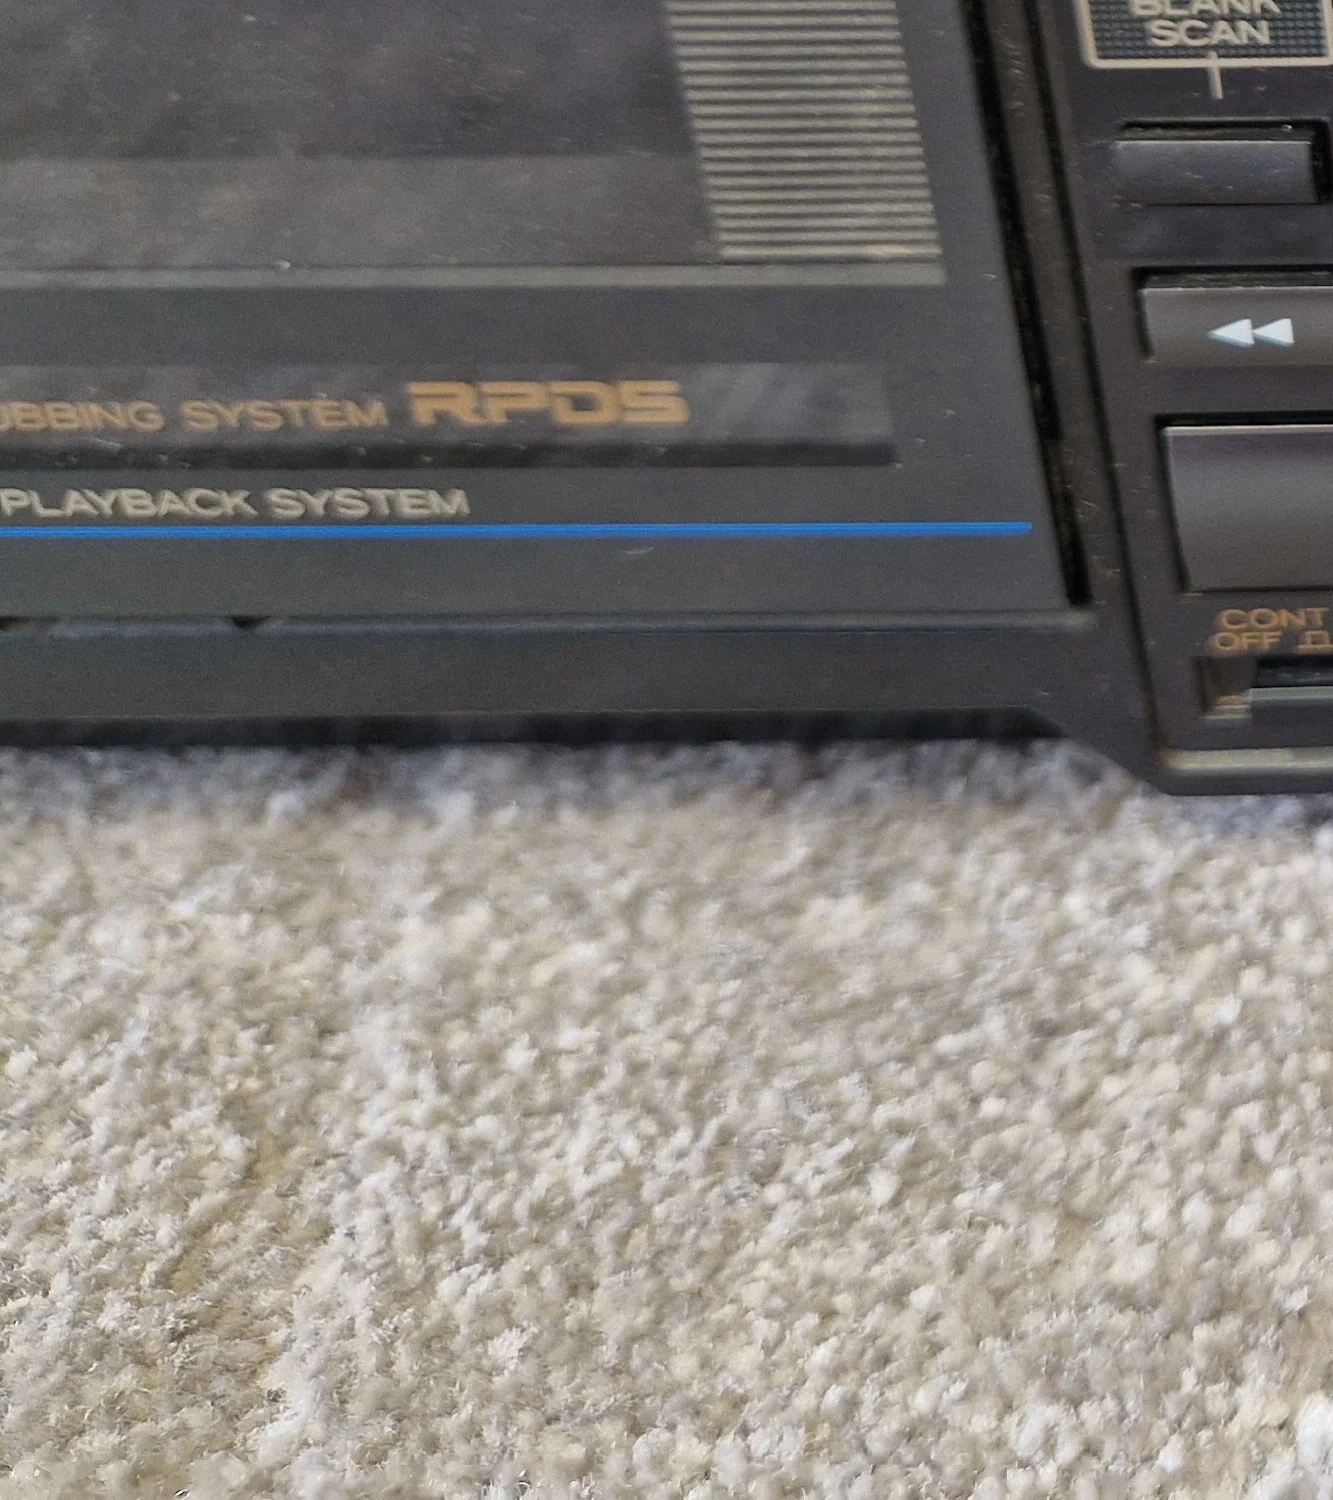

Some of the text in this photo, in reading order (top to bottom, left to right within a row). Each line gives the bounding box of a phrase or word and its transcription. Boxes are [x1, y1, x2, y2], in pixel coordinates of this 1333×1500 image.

[1147, 19, 1272, 46] SCAN
[179, 398, 389, 431] SYSTEM
[408, 380, 689, 426] RPDS
[264, 486, 470, 519] SYSTEM
[1216, 607, 1328, 631] CONT
[1209, 630, 1282, 654] OFF
